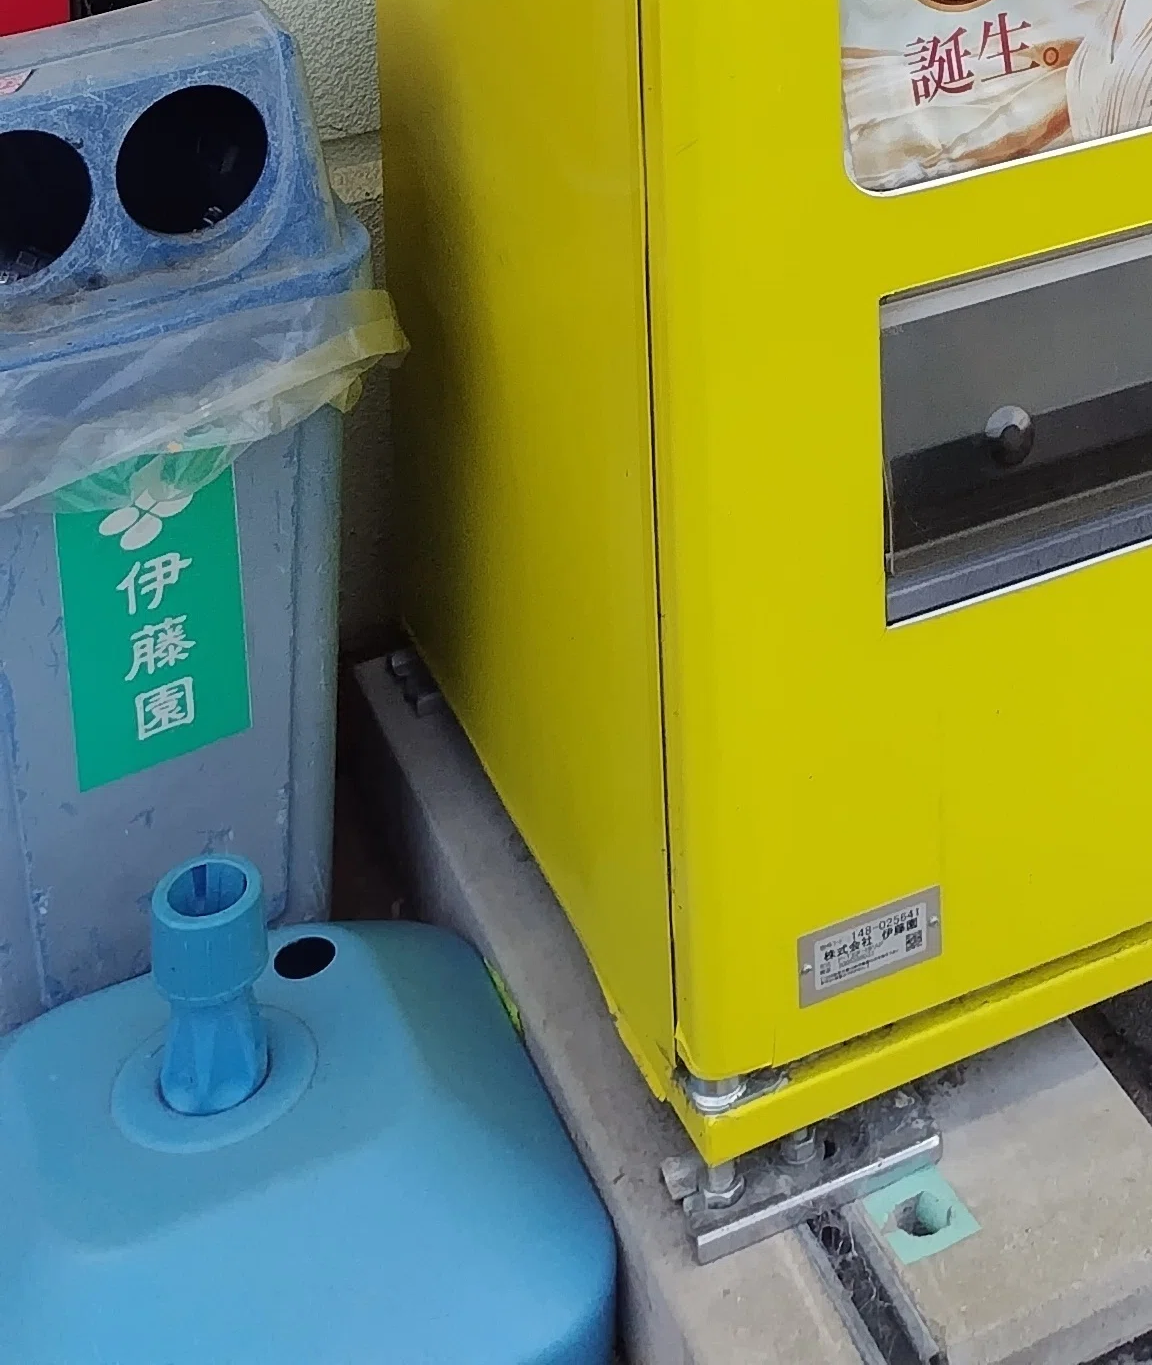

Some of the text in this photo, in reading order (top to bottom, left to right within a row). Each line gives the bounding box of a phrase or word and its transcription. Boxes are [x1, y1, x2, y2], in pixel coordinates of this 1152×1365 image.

[904, 10, 1061, 108] 誕生。
[115, 549, 196, 742] 伊藤園
[823, 935, 873, 962] 株式会社
